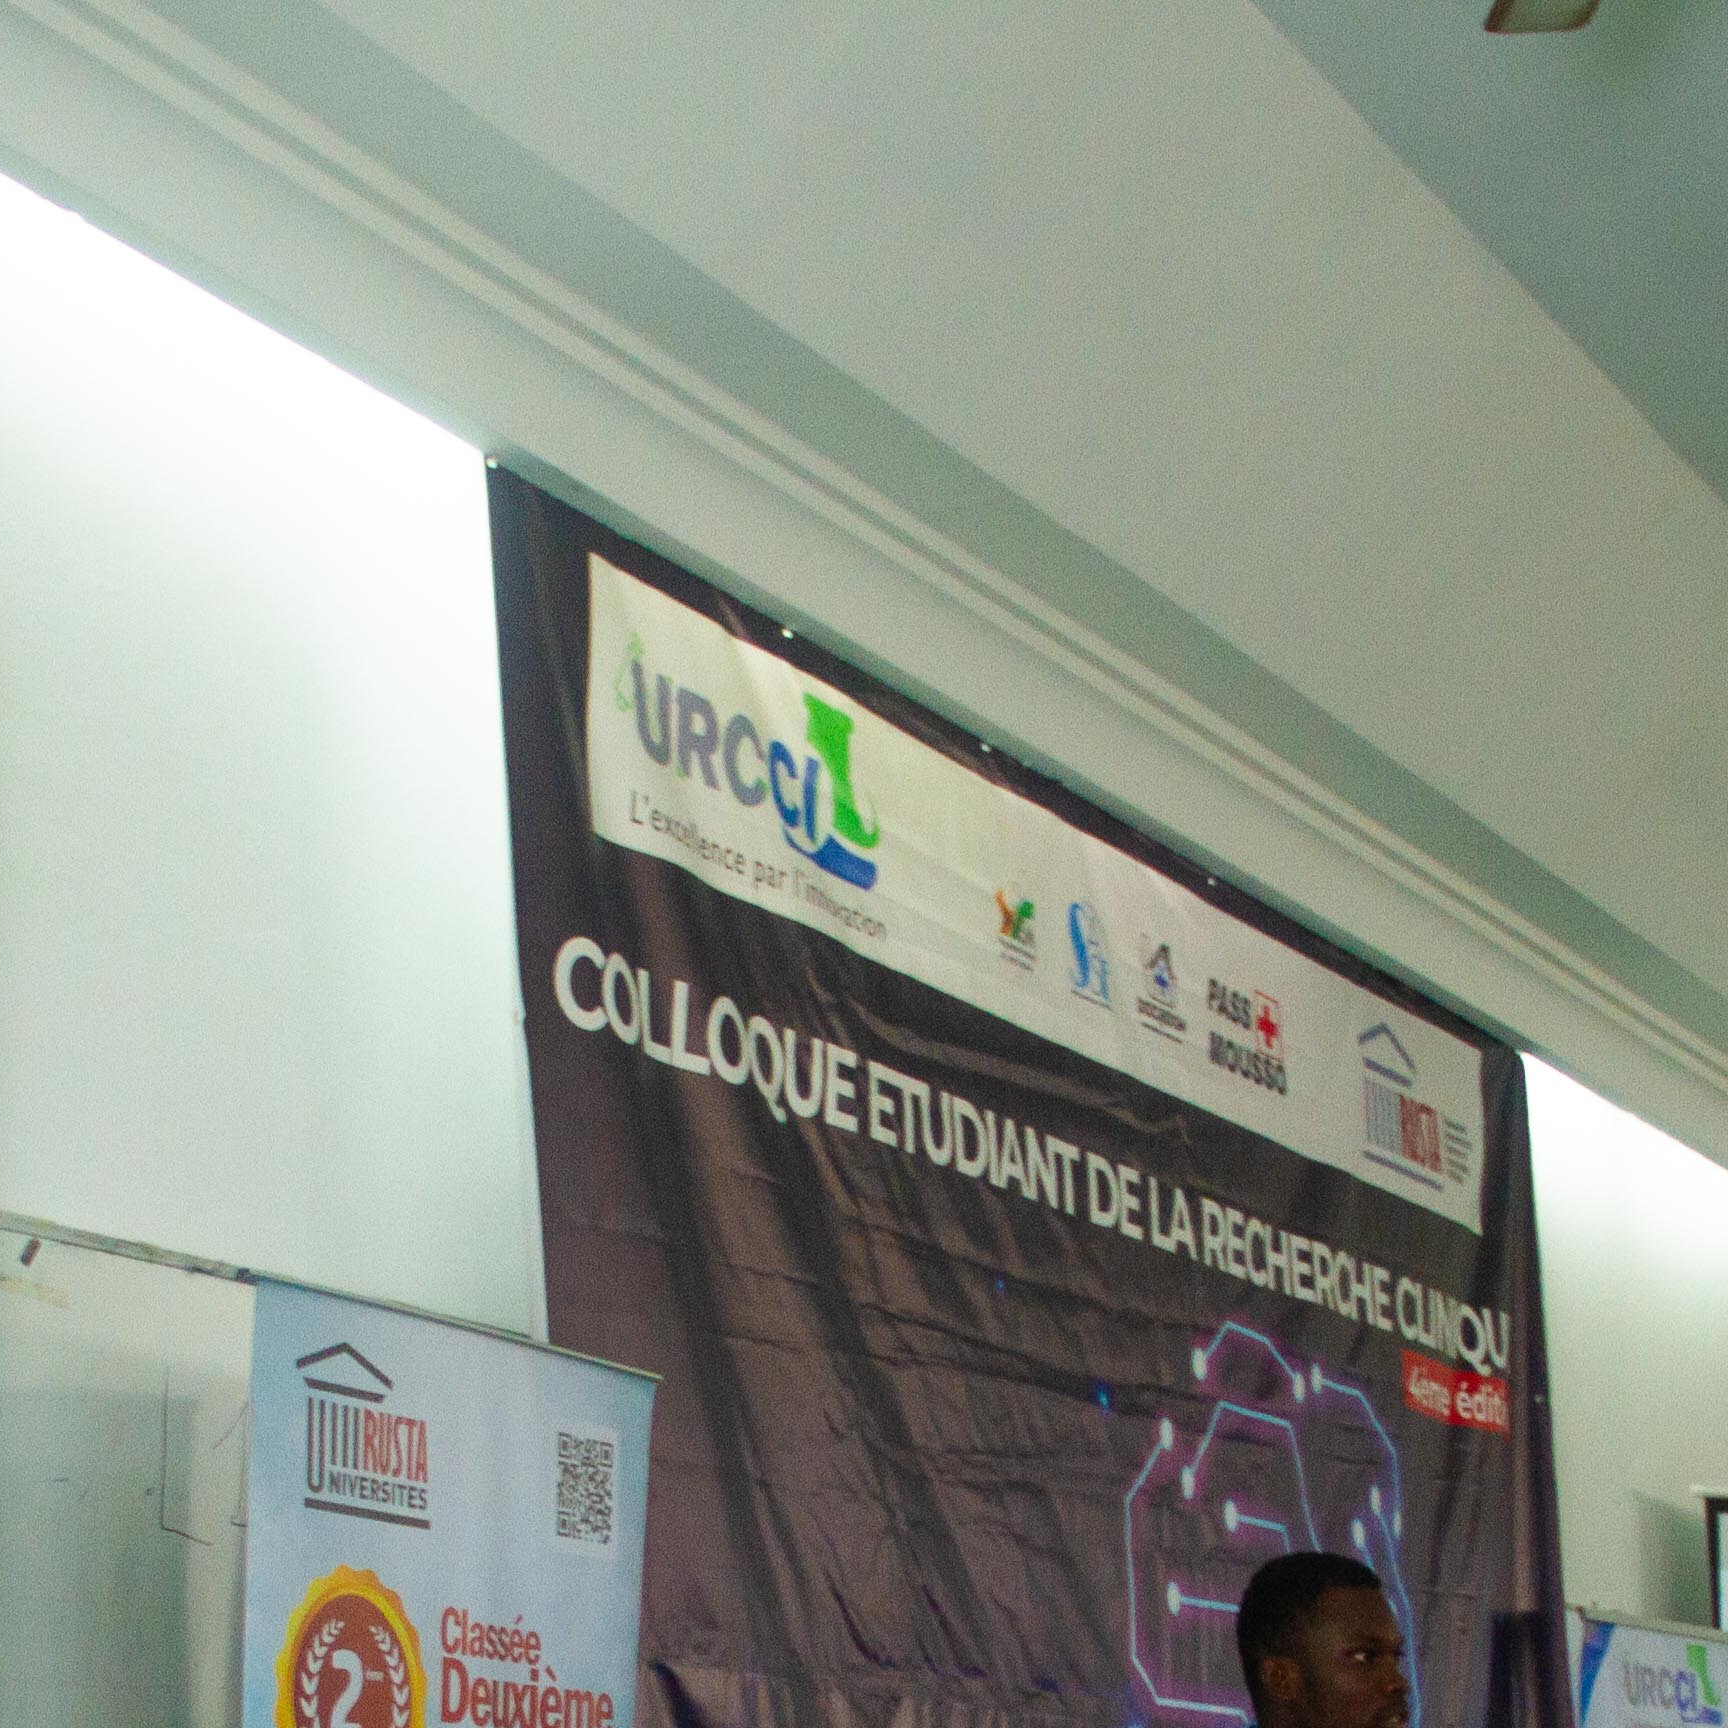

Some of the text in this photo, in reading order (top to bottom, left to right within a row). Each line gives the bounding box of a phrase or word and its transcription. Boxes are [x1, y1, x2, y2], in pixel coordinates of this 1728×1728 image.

[630, 660, 820, 846] URCCI
[751, 860, 789, 892] par
[1208, 977, 1251, 1031] PASS
[1208, 1031, 1288, 1096] MOUSSO
[553, 936, 860, 1133] COLLOQUE
[869, 1059, 1081, 1216] ETUDIANT
[1085, 1151, 1144, 1241] DE
[1149, 1176, 1198, 1261] LA
[1201, 1196, 1394, 1332] RECHERCHE
[441, 1606, 541, 1665] Classée
